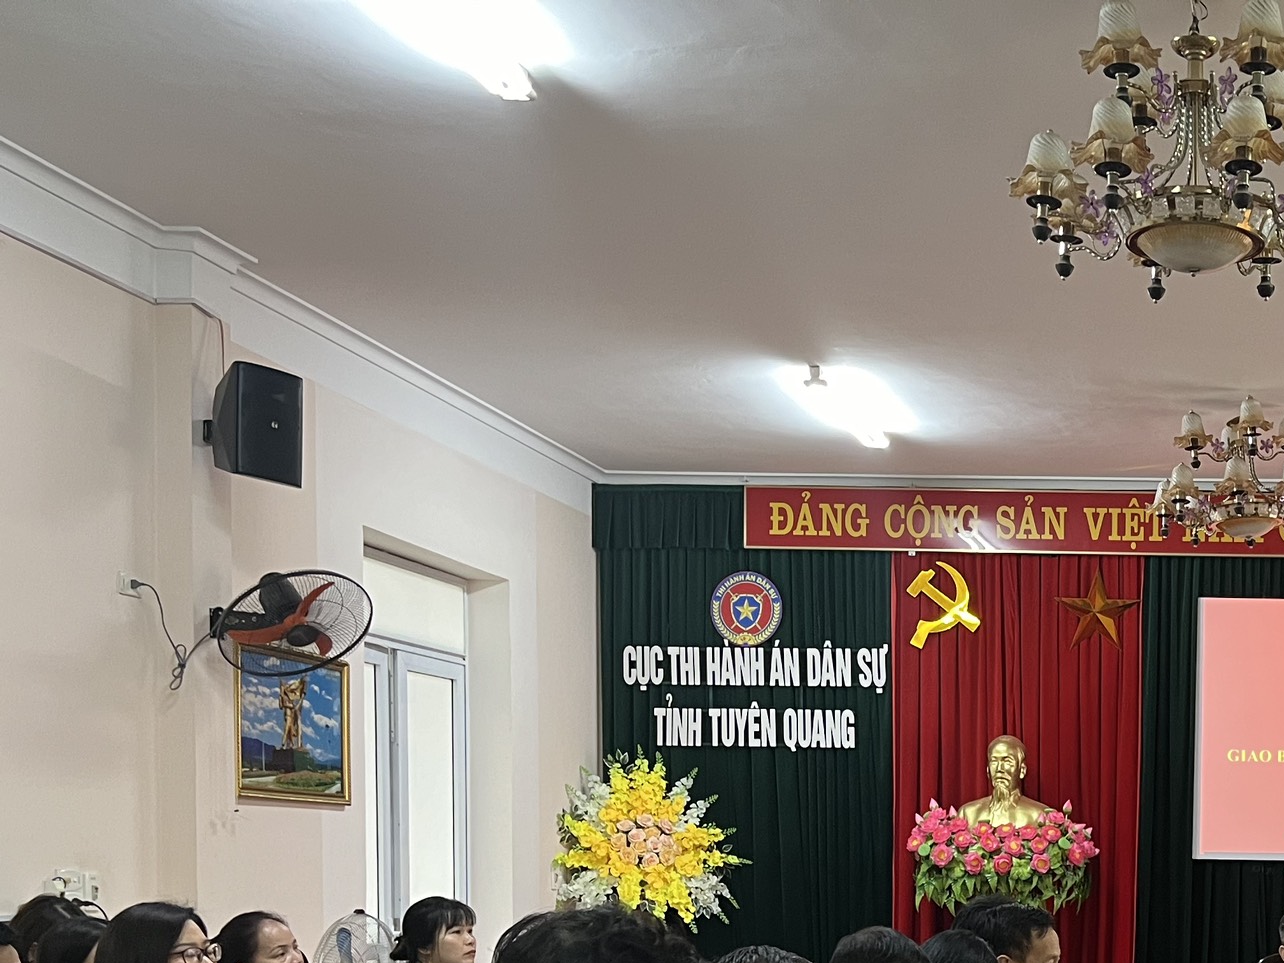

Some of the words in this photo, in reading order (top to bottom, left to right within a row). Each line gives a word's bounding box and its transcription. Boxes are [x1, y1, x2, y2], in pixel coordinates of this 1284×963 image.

[768, 491, 870, 538] ĐẢNG
[883, 494, 979, 547] CỘNG
[995, 495, 1067, 541] SẢN
[622, 645, 664, 691] CỤC
[667, 646, 700, 686] THI
[706, 638, 765, 687] HÀNH
[769, 639, 800, 687] ÁN
[806, 640, 852, 687] DÂN
[857, 643, 889, 694] SỰ
[653, 693, 702, 747] TỈNH
[708, 701, 777, 748] TUYÊN
[783, 708, 856, 752] QUANG
[1227, 749, 1272, 763] GIAO
